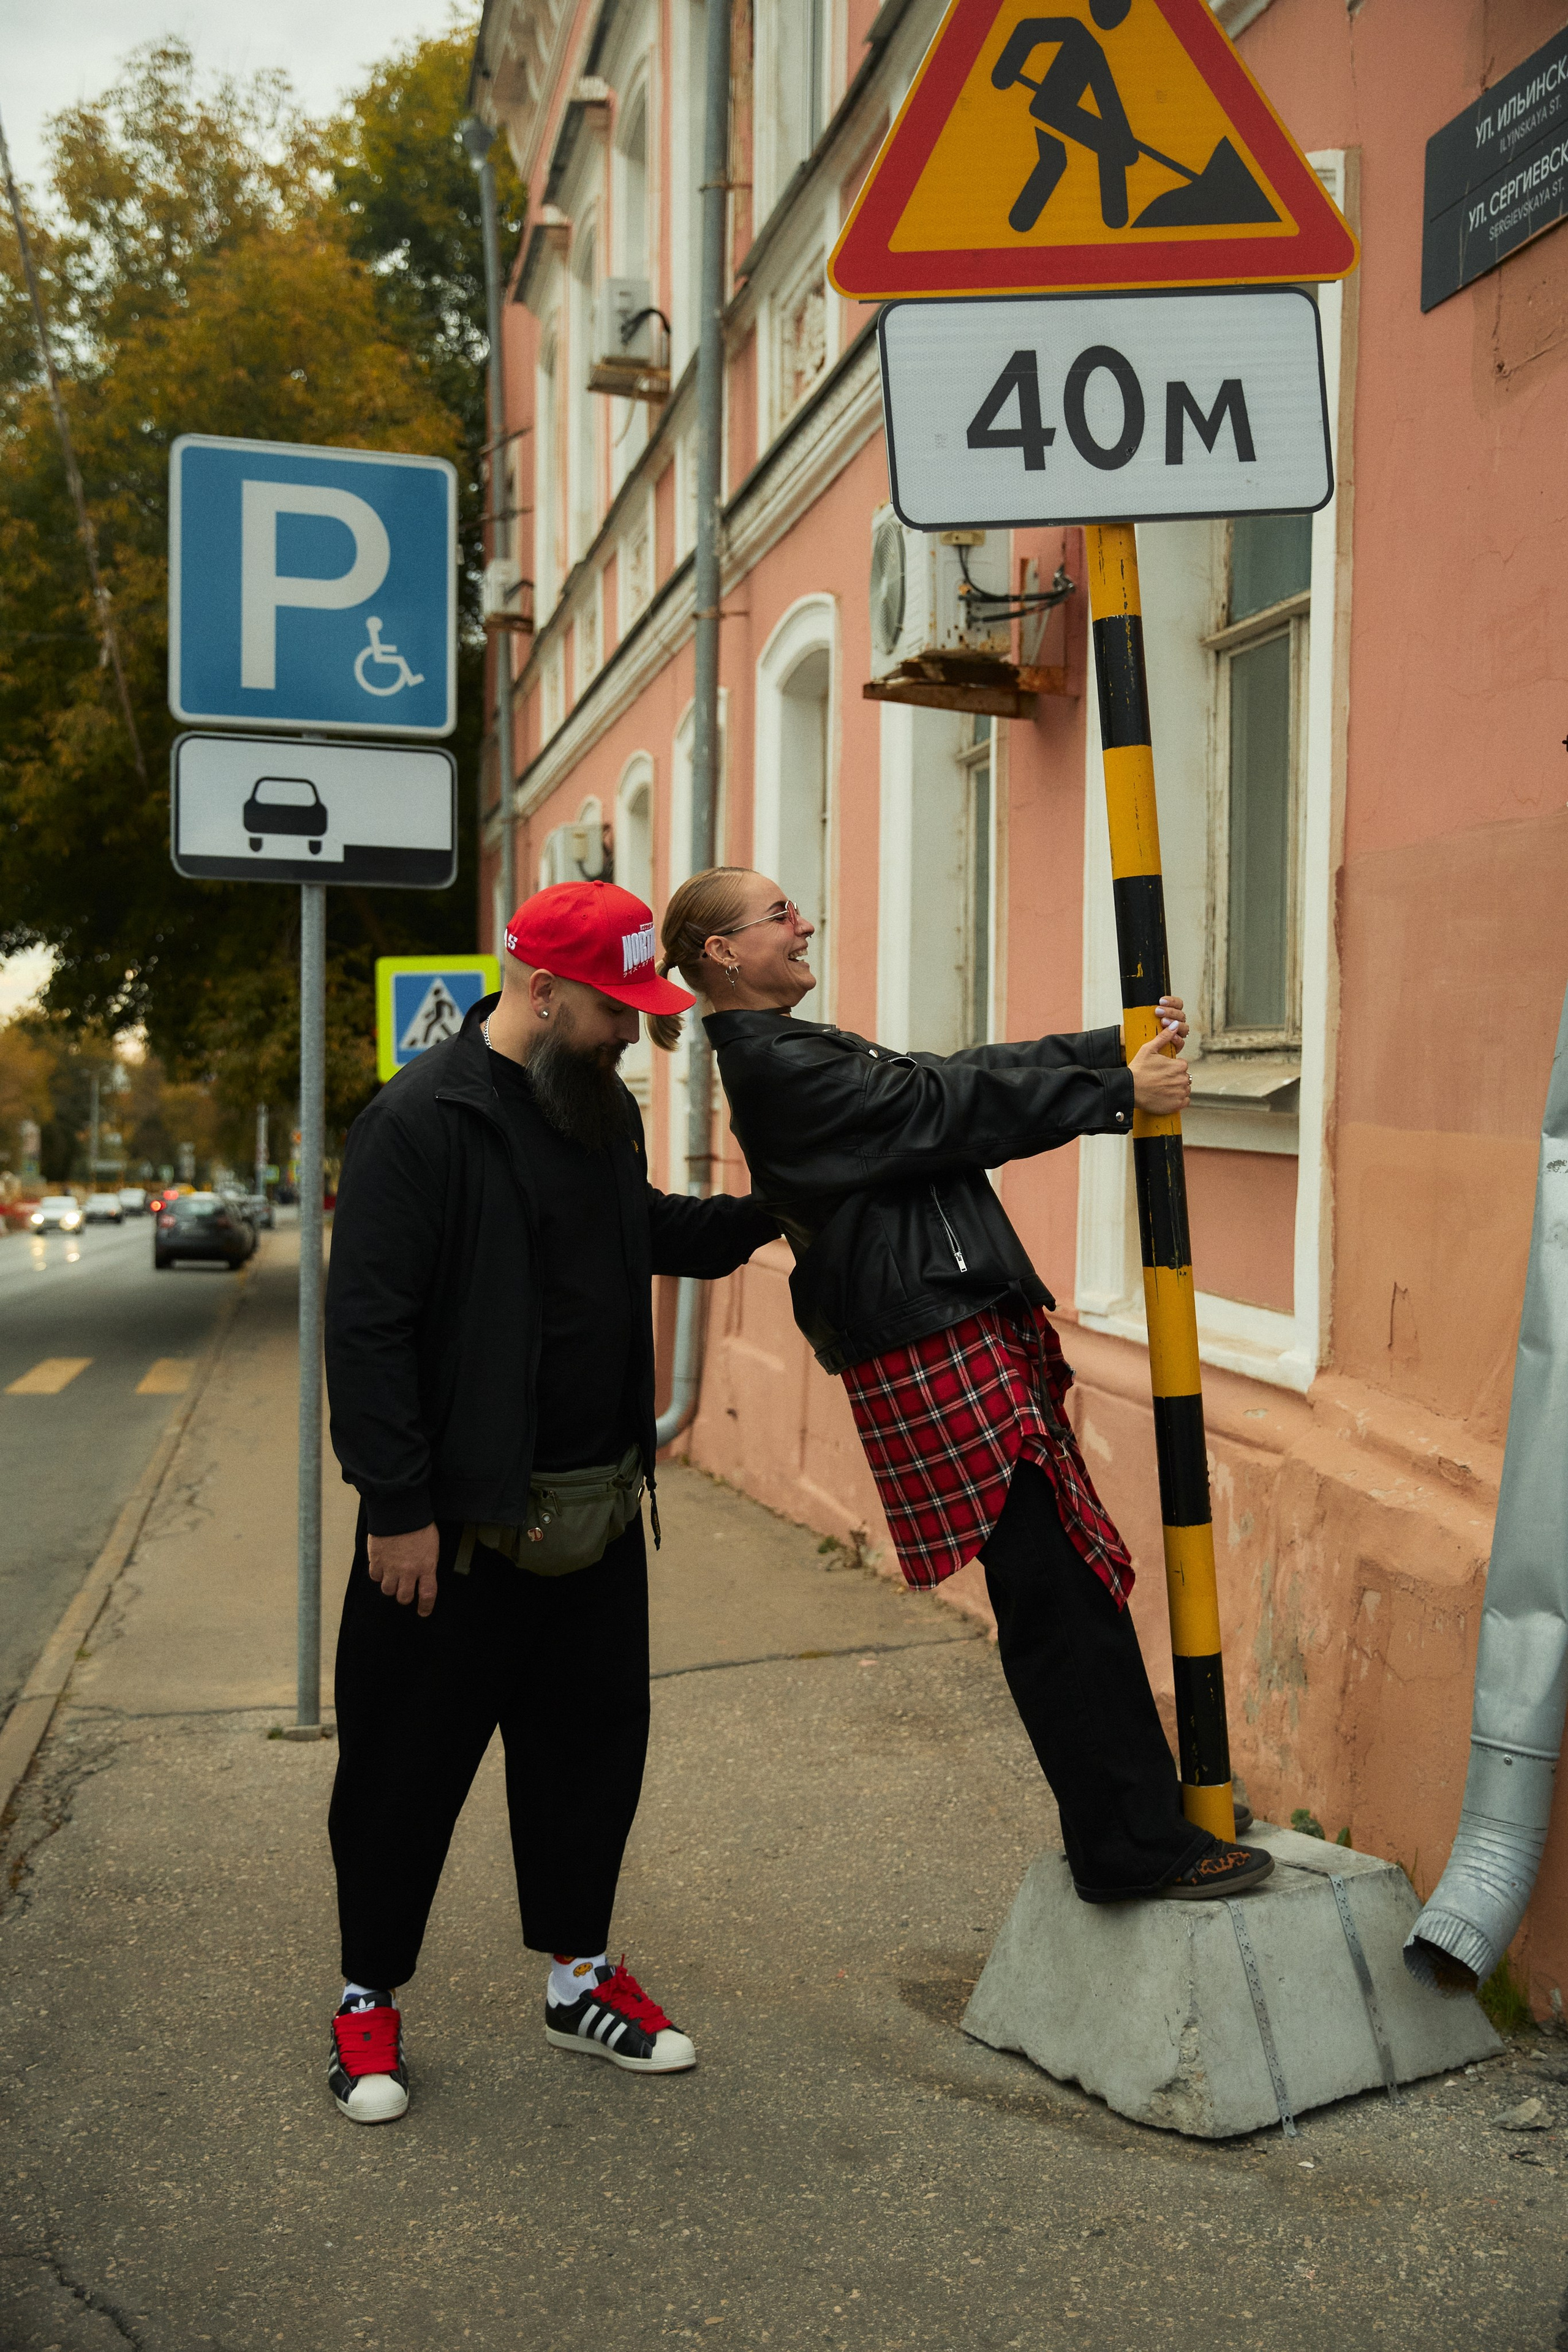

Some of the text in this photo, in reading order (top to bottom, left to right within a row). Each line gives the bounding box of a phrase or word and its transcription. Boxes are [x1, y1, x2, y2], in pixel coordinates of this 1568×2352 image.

[1476, 55, 1568, 149] УЛ. ИЛЬИНСК
[1499, 94, 1562, 153] ILYINSKAYA ST.
[1469, 202, 1487, 232] УЛ.
[1489, 176, 1565, 241] SERGIEVSKAYA ST.
[241, 479, 391, 690] P
